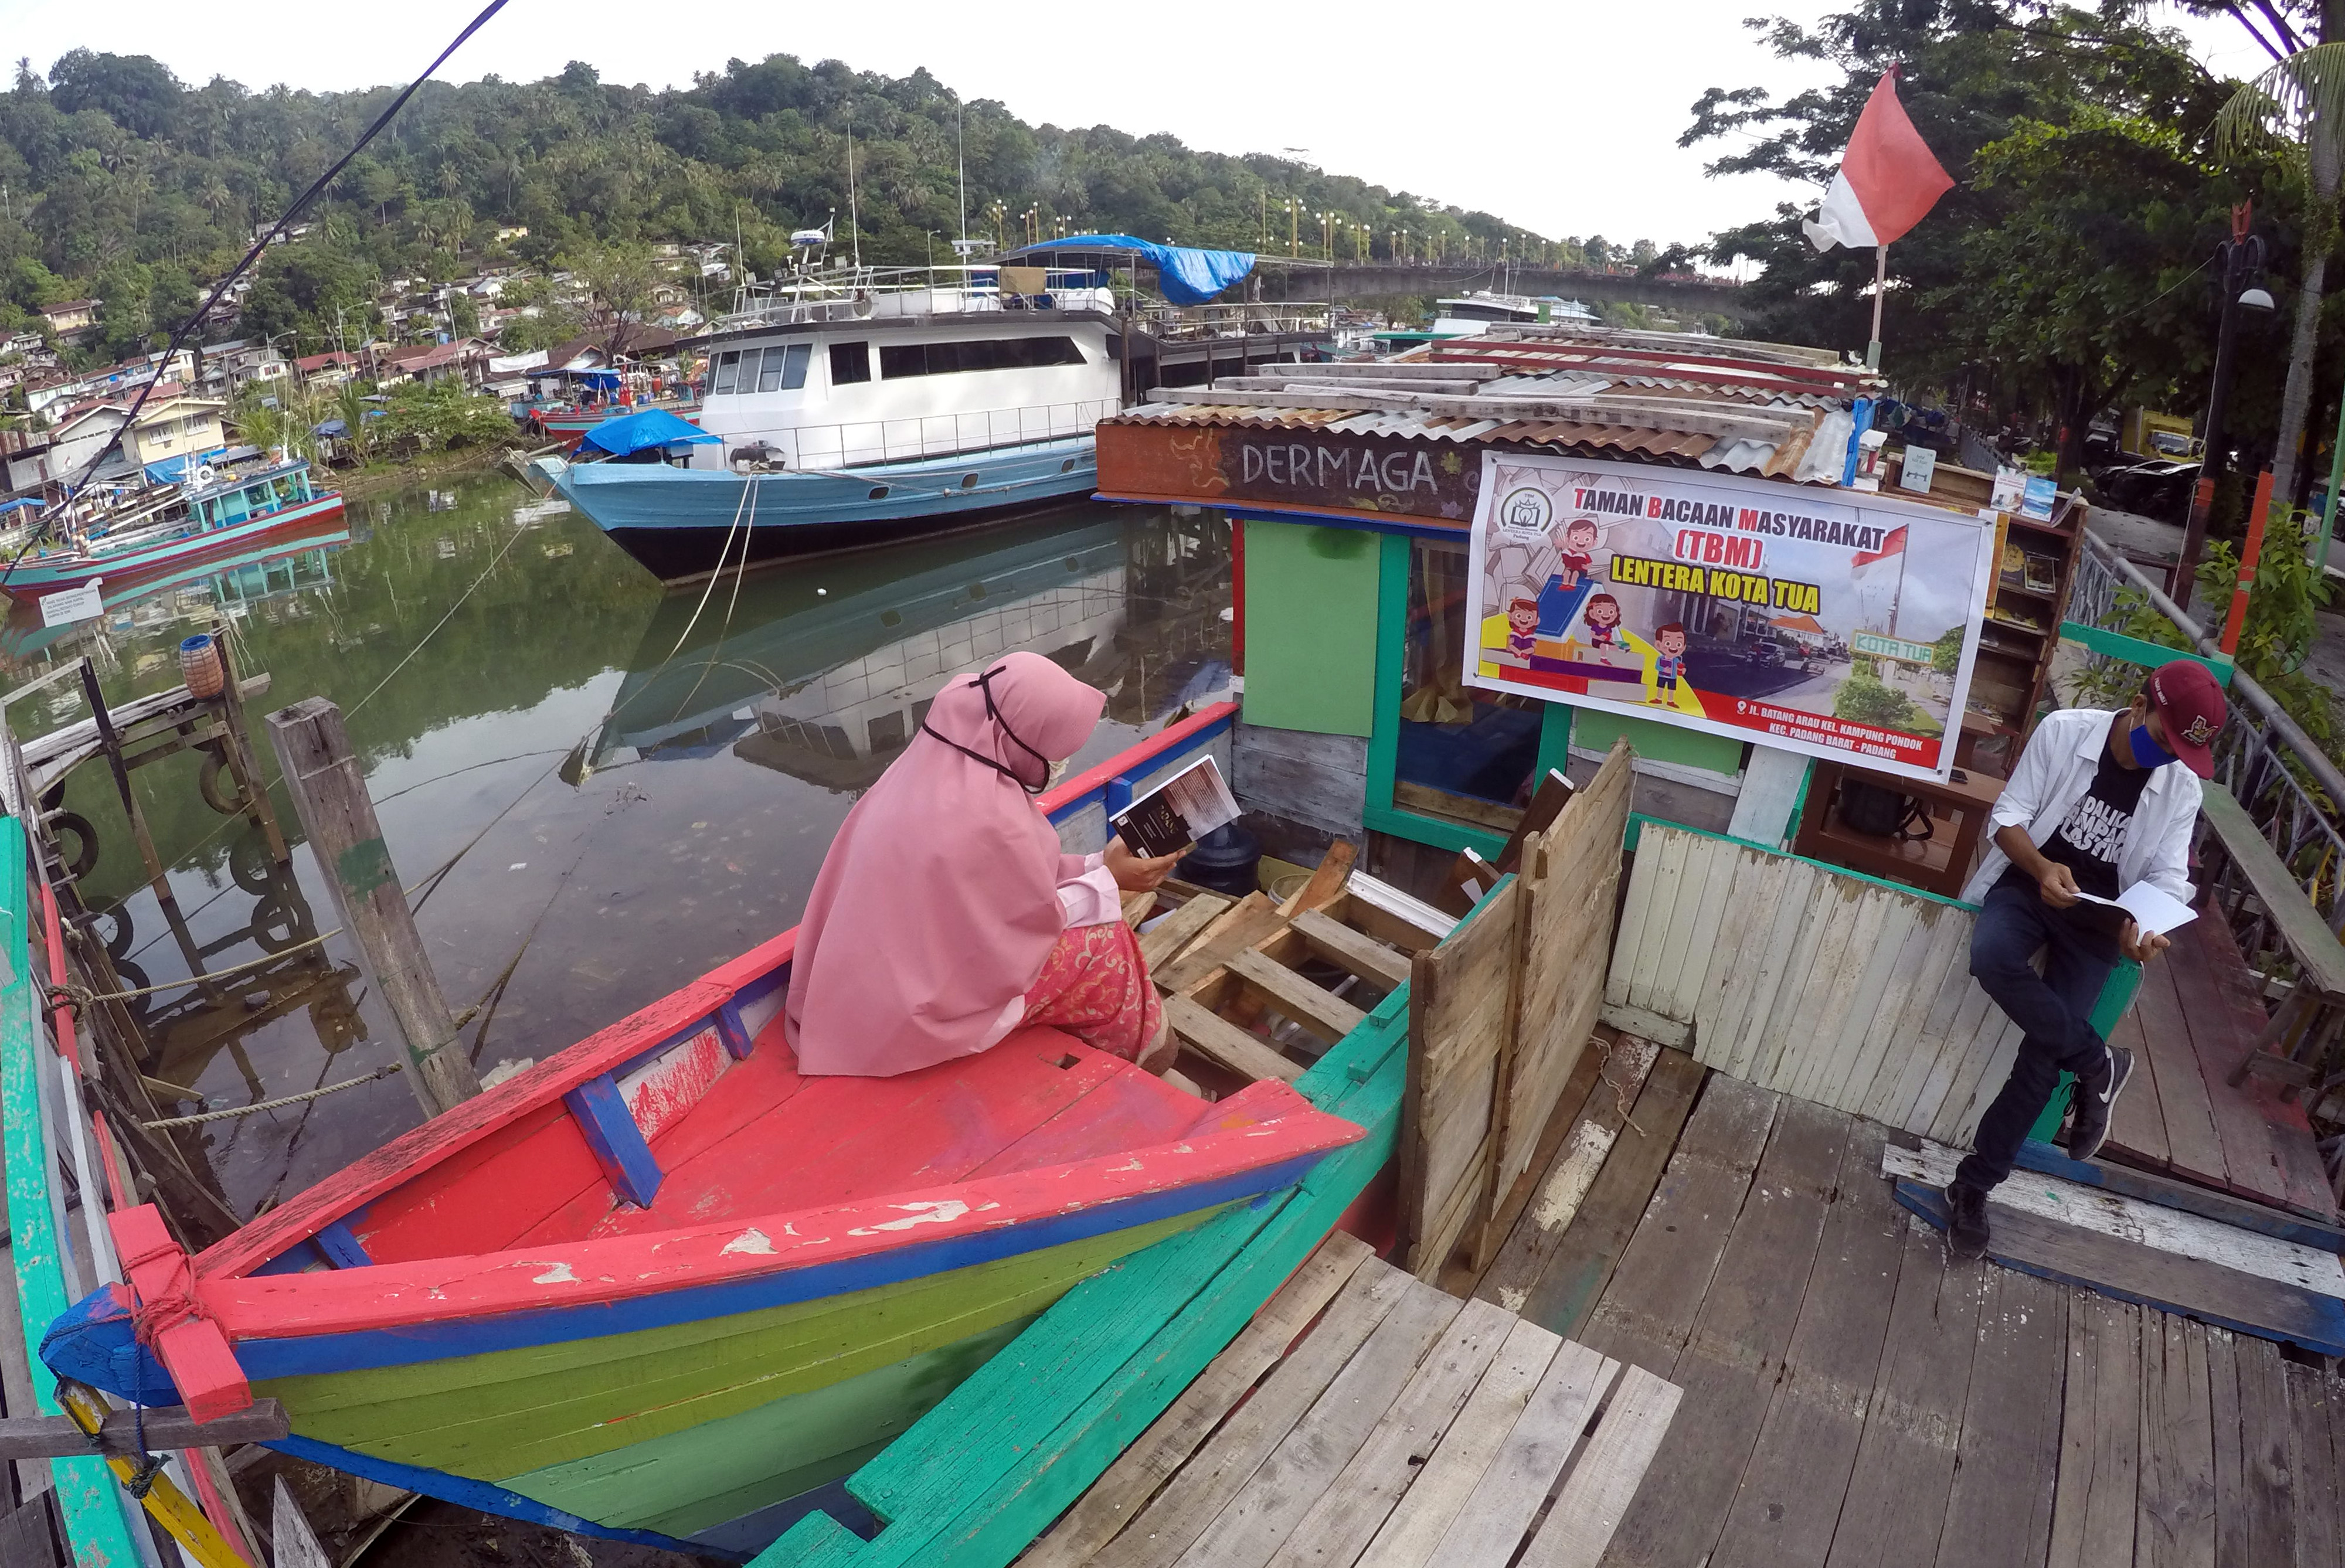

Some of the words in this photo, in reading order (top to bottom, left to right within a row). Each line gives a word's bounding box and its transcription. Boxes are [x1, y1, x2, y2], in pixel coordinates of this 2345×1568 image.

[1242, 443, 1439, 495] DERMAGA
[1574, 488, 1644, 516] TAMAN
[1647, 496, 1734, 528] BACAAN
[1738, 508, 1885, 551] MASYARAKAT
[1676, 529, 1763, 570] (TBM)
[1611, 556, 1705, 594] LENTERA
[1708, 570, 1768, 604] KOTA
[1773, 580, 1819, 614] TUA
[1857, 634, 1899, 656] KOTA
[1904, 643, 1931, 662] TUA
[1749, 705, 1759, 716] JL.
[1761, 708, 1795, 723] BATANG
[1795, 715, 1820, 729] ARAU
[1820, 720, 1838, 733] KEL.
[1840, 724, 1884, 742] KAMPUNG
[1885, 733, 1923, 751] PONDOK
[1769, 723, 1788, 736] KEC.
[1789, 727, 1824, 743] PADANG
[1826, 735, 1855, 750] BARAT
[1860, 742, 1897, 760] PADANG
